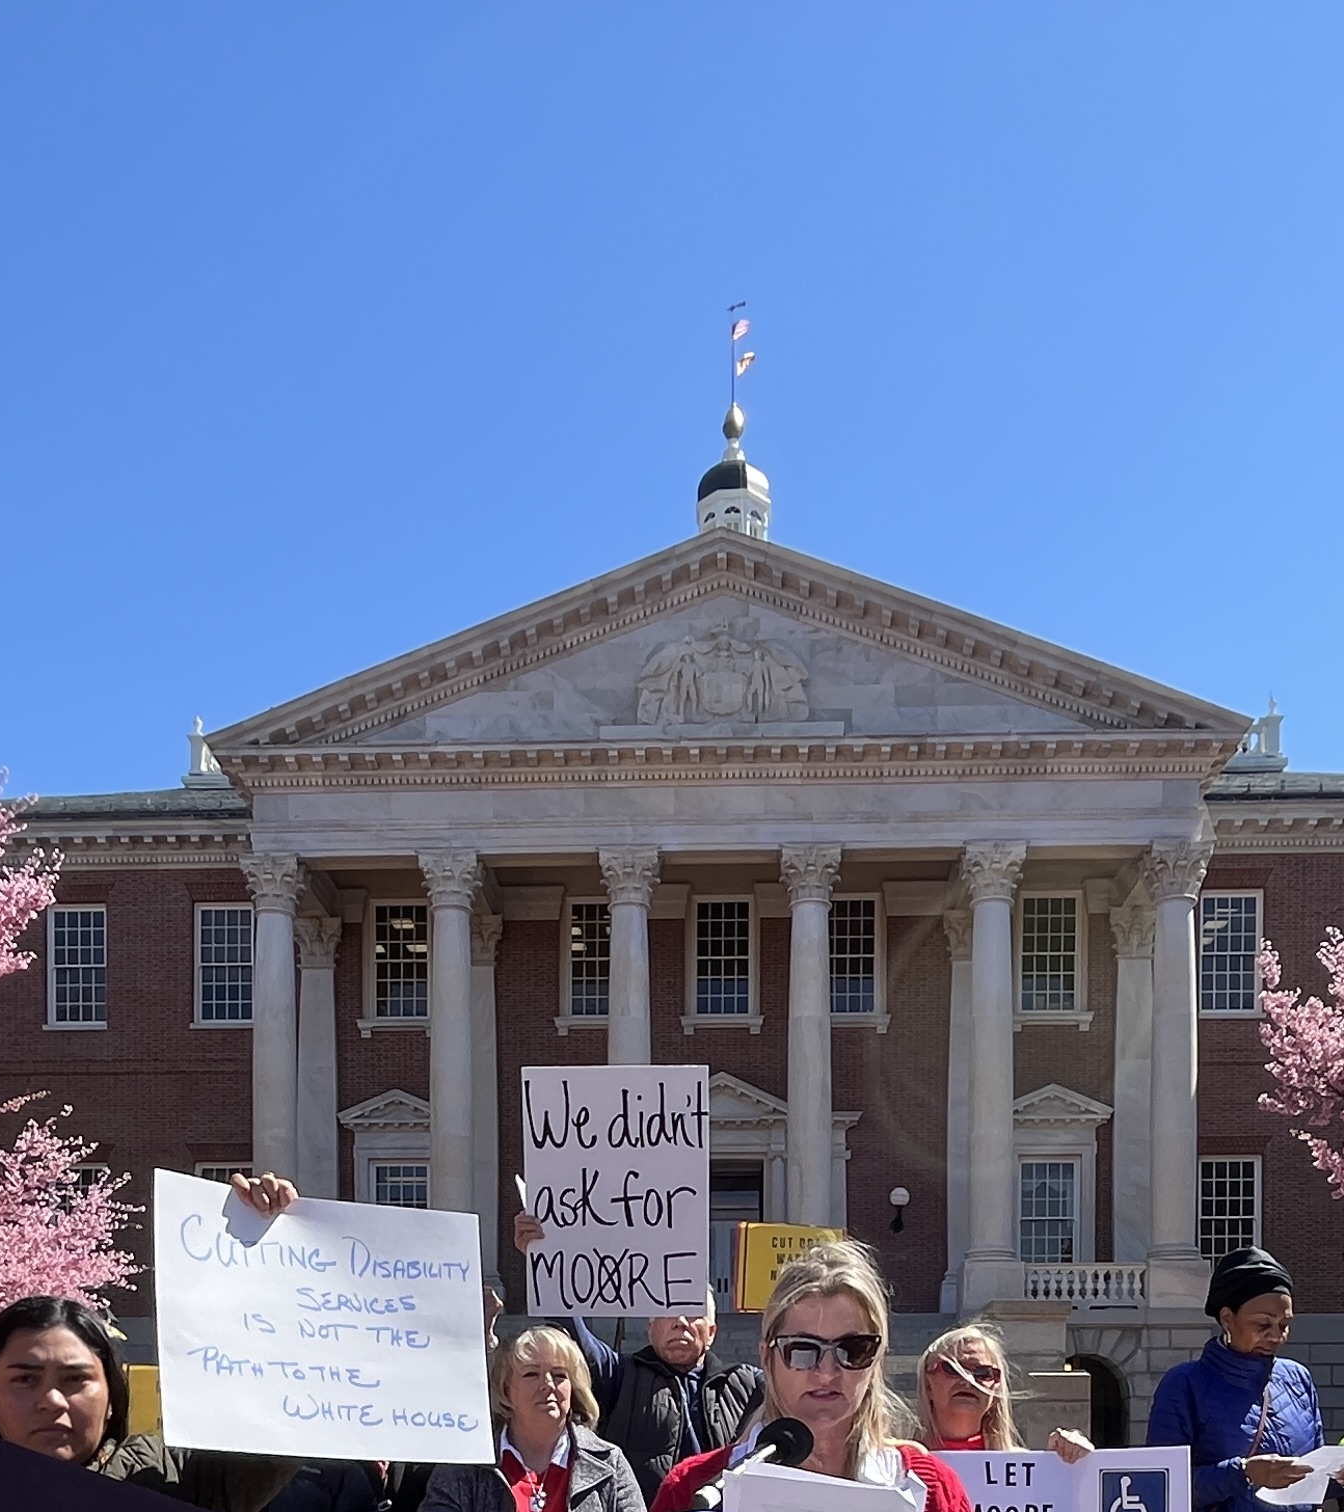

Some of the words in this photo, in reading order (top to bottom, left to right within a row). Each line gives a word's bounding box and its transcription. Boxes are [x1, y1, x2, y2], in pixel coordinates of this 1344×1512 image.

[524, 1080, 598, 1149] We
[608, 1081, 709, 1149] didn't
[534, 1167, 619, 1228] ask
[610, 1170, 697, 1229] for
[180, 1214, 337, 1273] CUTTING
[342, 1236, 471, 1283] DISABILITY
[771, 1237, 793, 1249] CUT
[296, 1287, 417, 1315] SERVICES
[243, 1312, 276, 1333] IS
[299, 1318, 358, 1342] NOT
[366, 1326, 431, 1349] THE
[187, 1346, 264, 1377] PATH
[268, 1361, 306, 1381] TO
[308, 1366, 381, 1389] THE
[283, 1394, 383, 1427] WHITE
[393, 1408, 479, 1432] HOUSE
[985, 1461, 1036, 1487] LET
